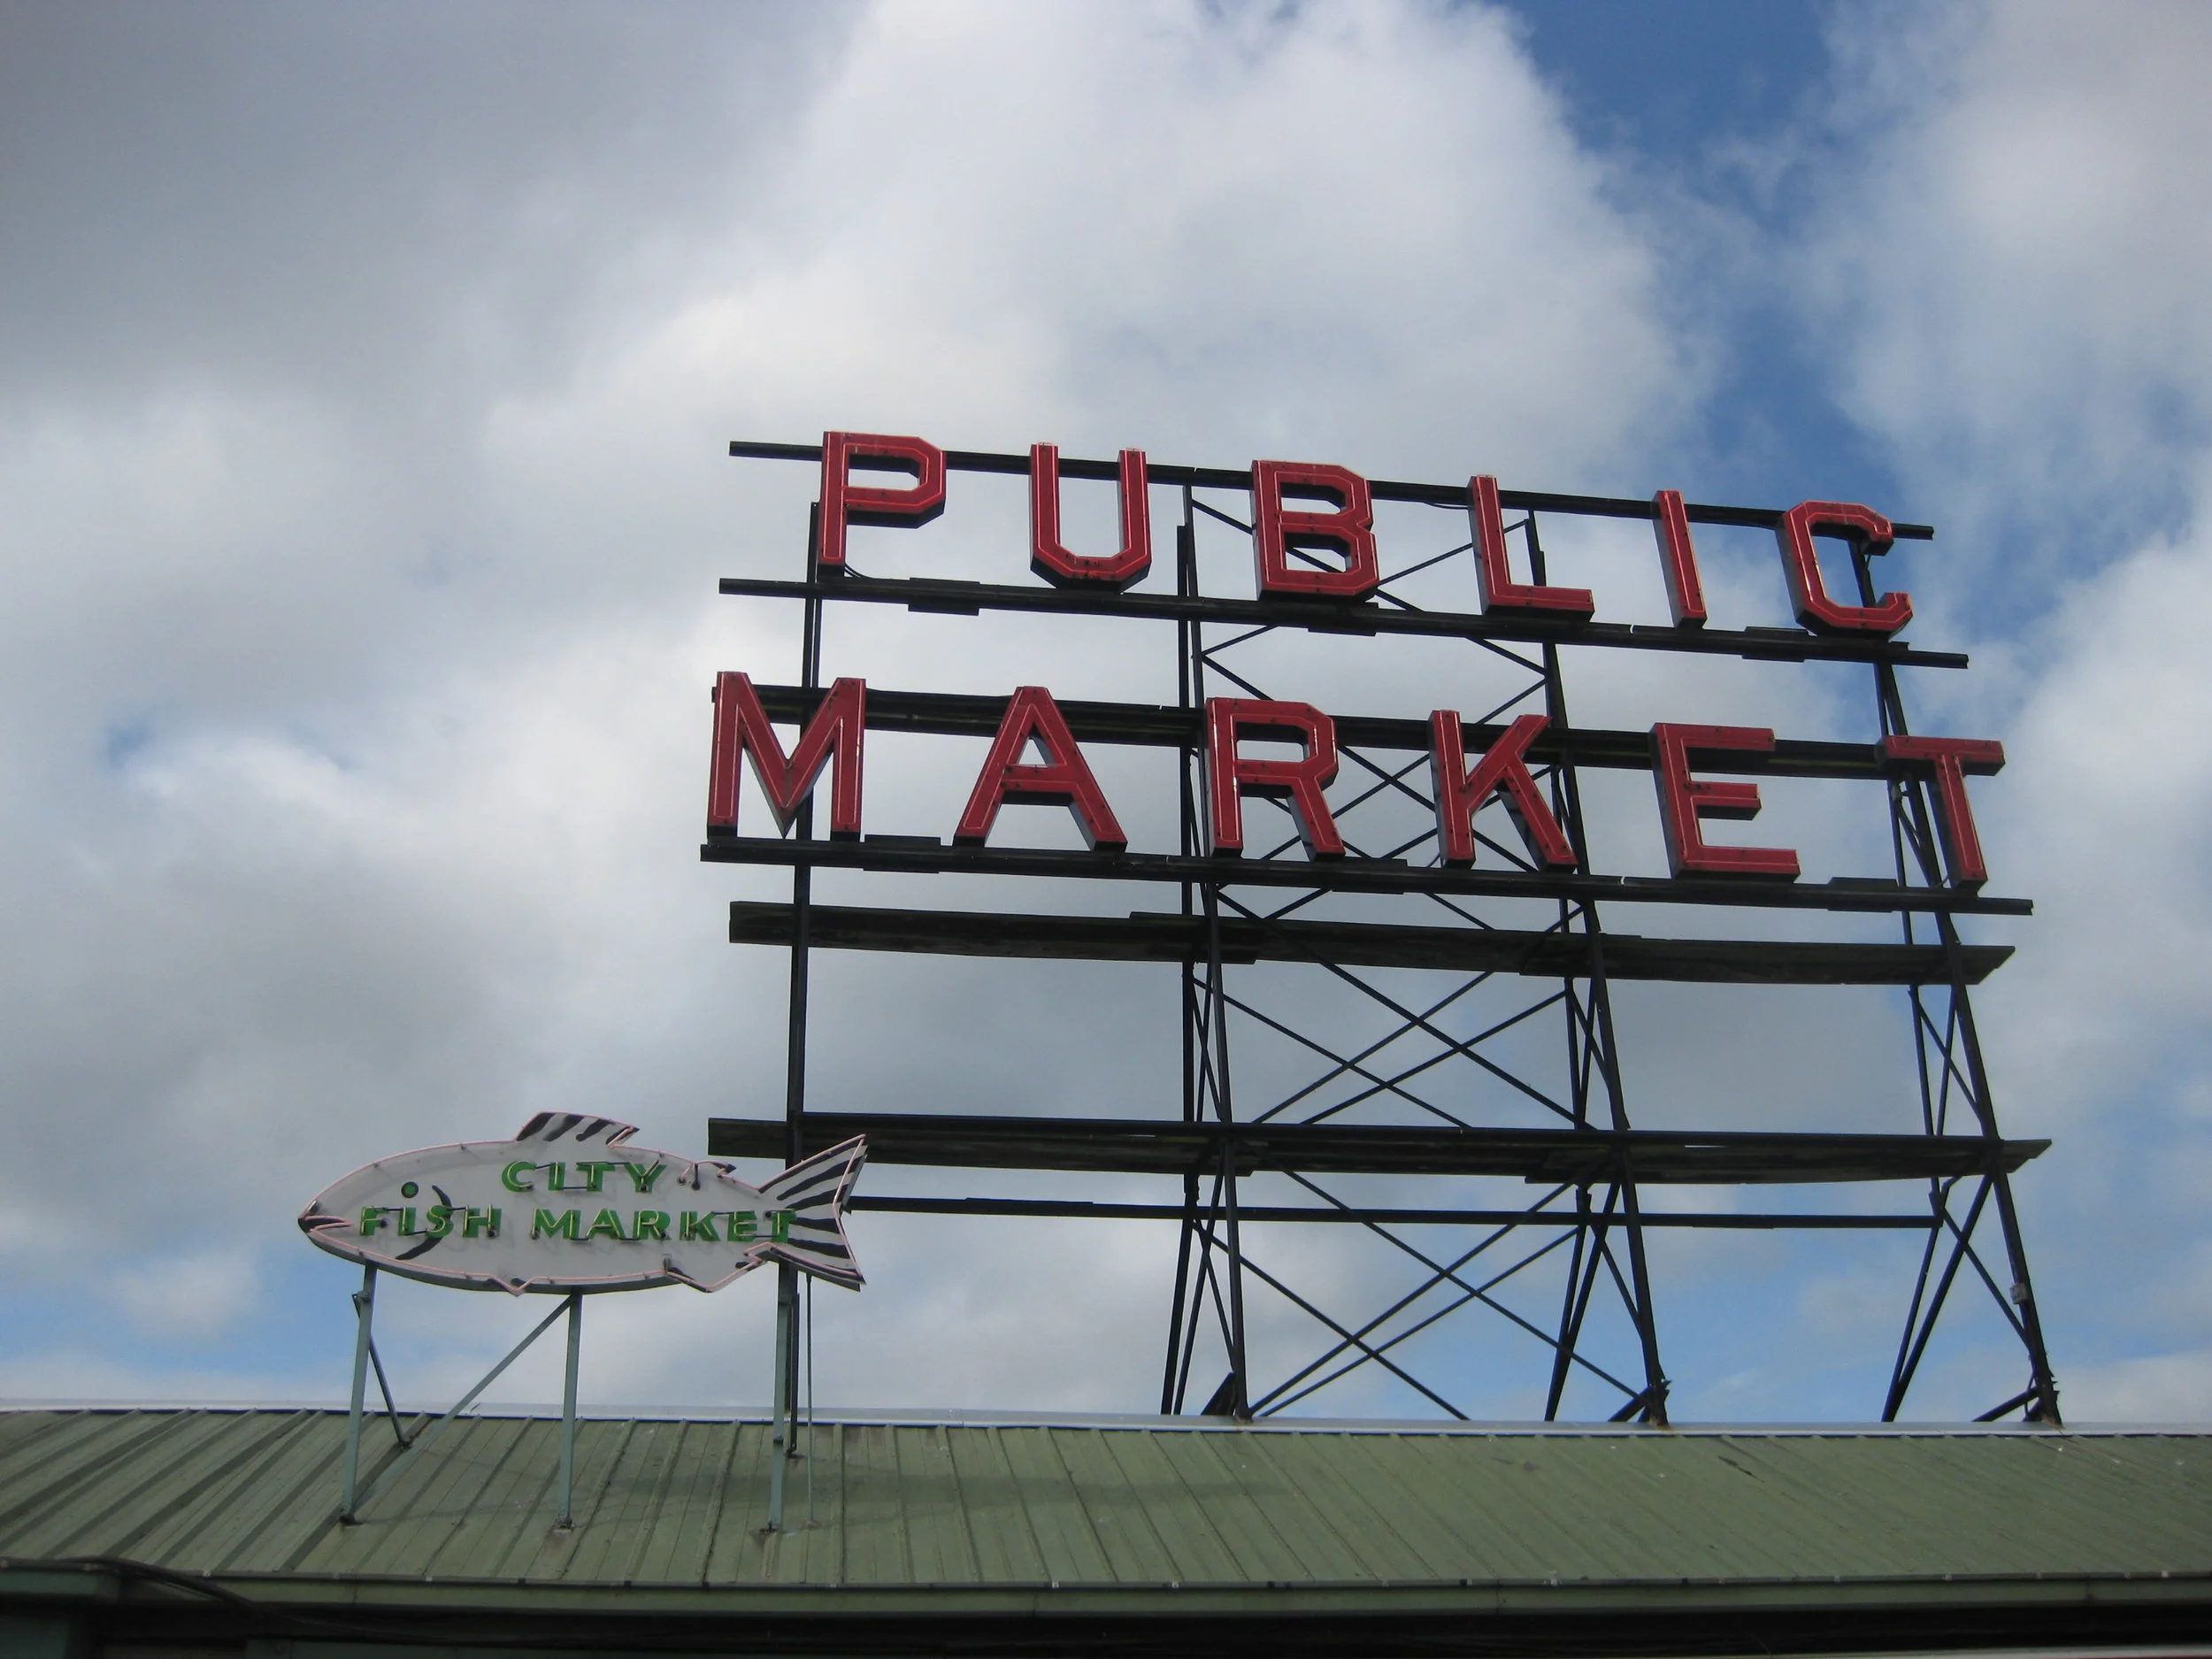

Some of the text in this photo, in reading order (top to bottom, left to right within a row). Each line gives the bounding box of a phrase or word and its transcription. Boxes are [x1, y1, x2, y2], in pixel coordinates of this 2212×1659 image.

[817, 431, 1913, 634] PUBLIC
[707, 670, 2006, 892] MARKET
[359, 1205, 796, 1243] FISH MARKET
[501, 1160, 668, 1194] CITY
